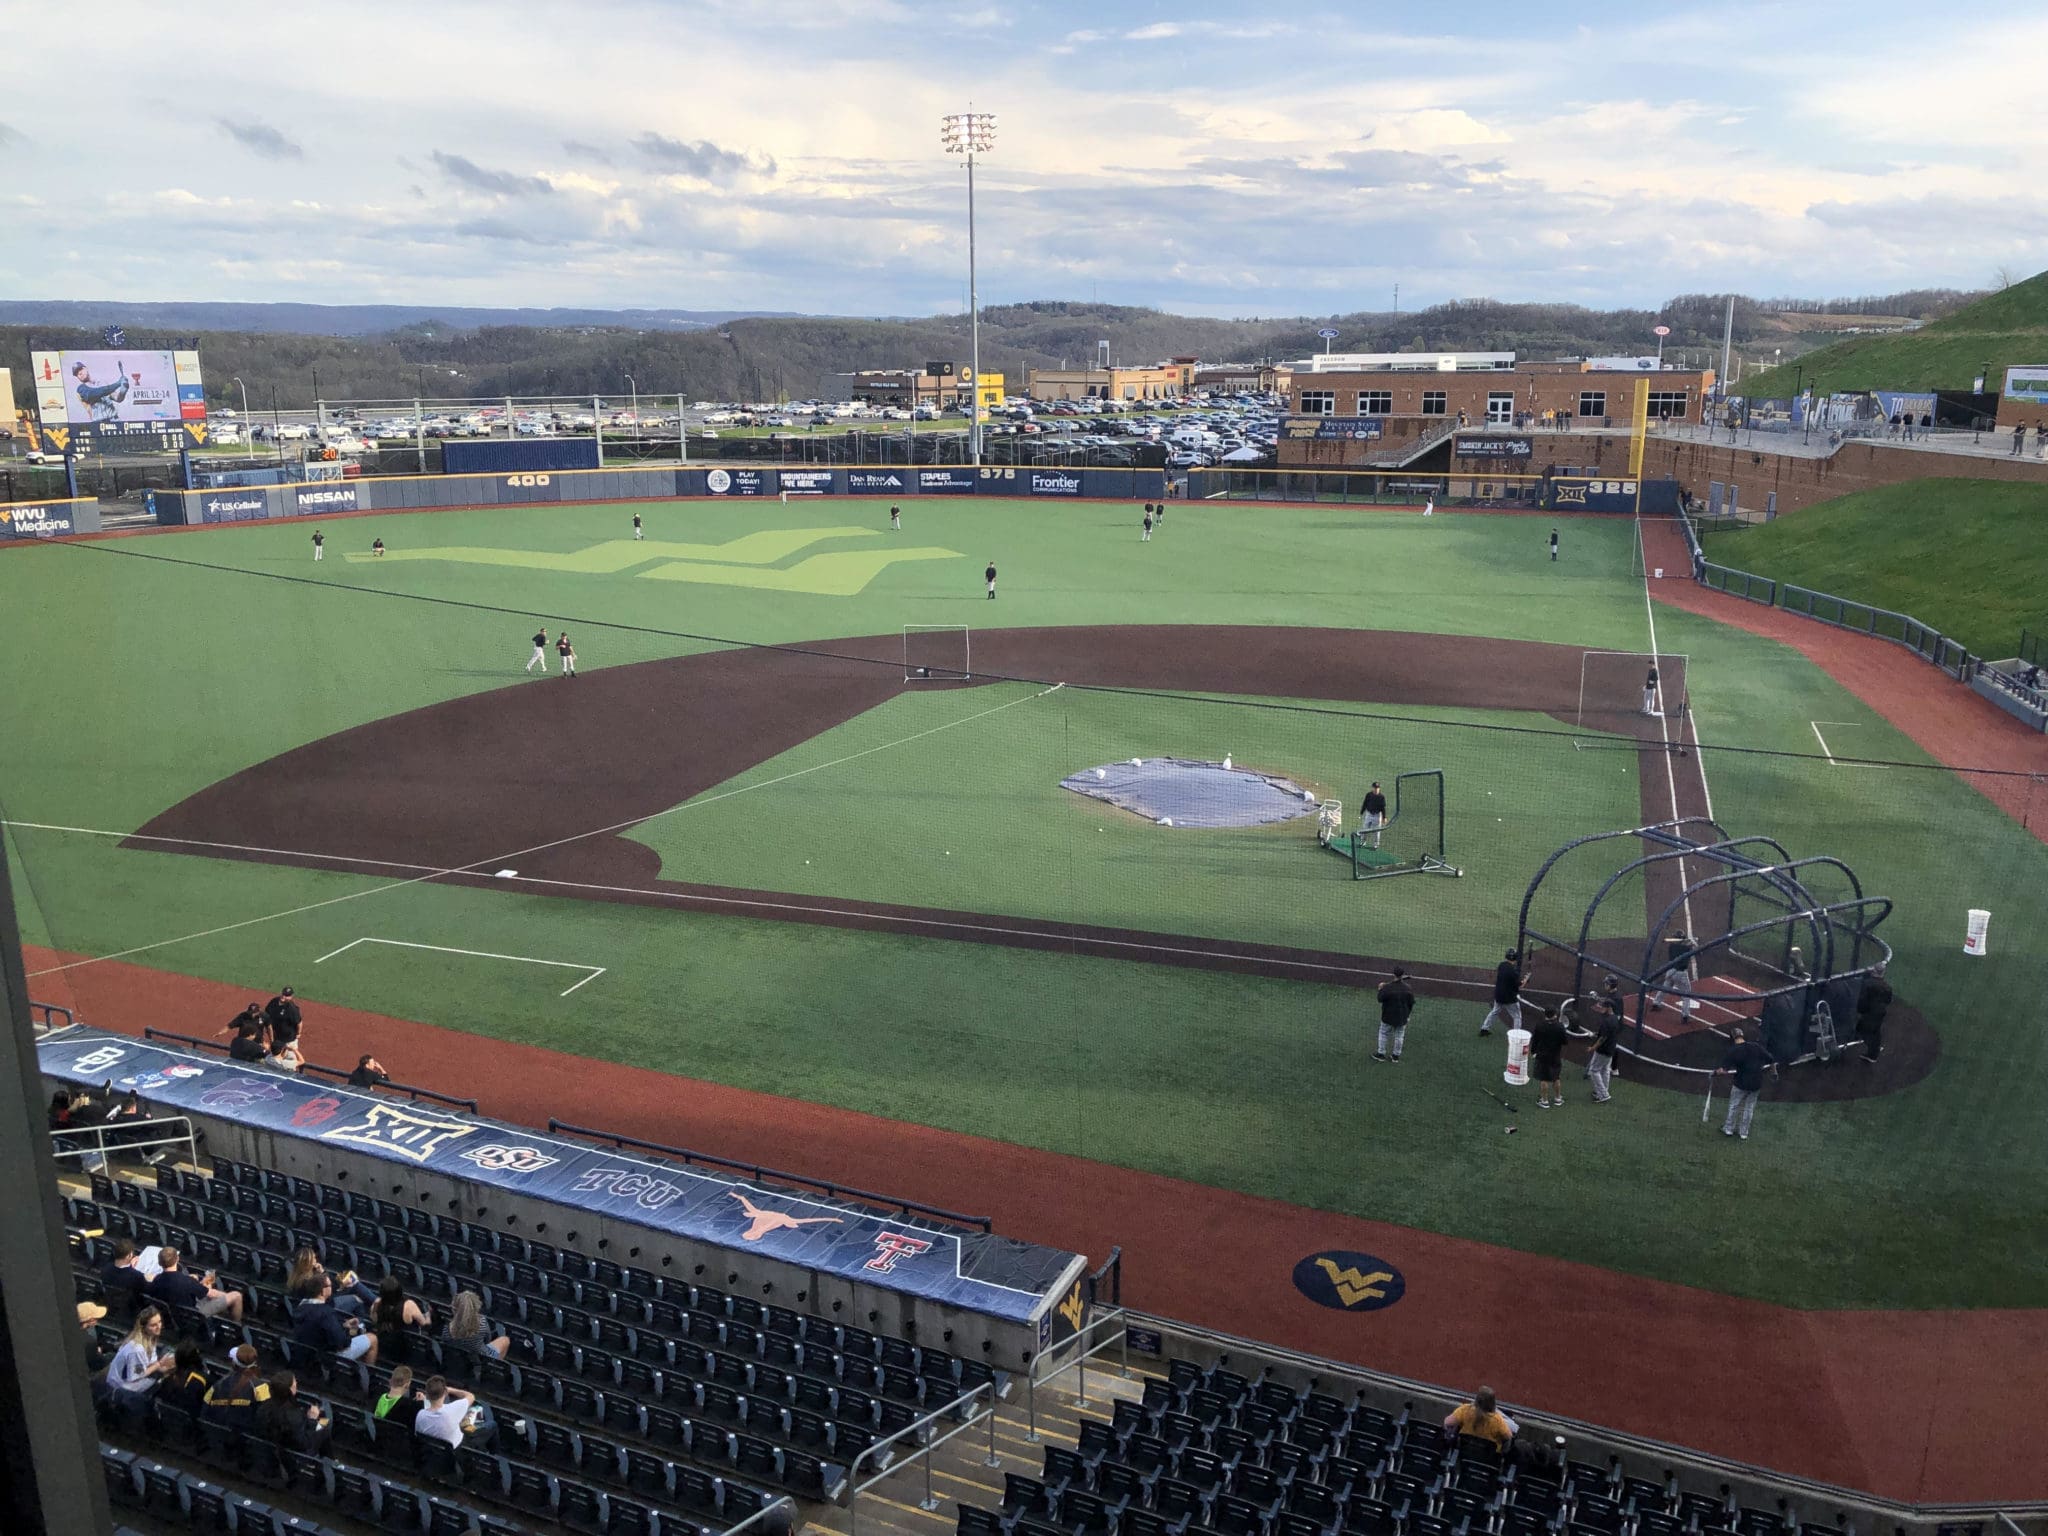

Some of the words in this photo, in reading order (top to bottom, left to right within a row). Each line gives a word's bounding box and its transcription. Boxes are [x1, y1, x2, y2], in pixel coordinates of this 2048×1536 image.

[134, 390, 150, 398] APRIL
[152, 390, 170, 398] 12-14
[508, 474, 550, 486] 400
[980, 469, 1015, 479] 375
[1032, 475, 1080, 488] Frontier
[1589, 482, 1636, 494] 325
[298, 490, 355, 505] NISSAN
[11, 508, 46, 520] WVU
[15, 520, 70, 532] Medicine
[571, 1168, 684, 1210] TCU
